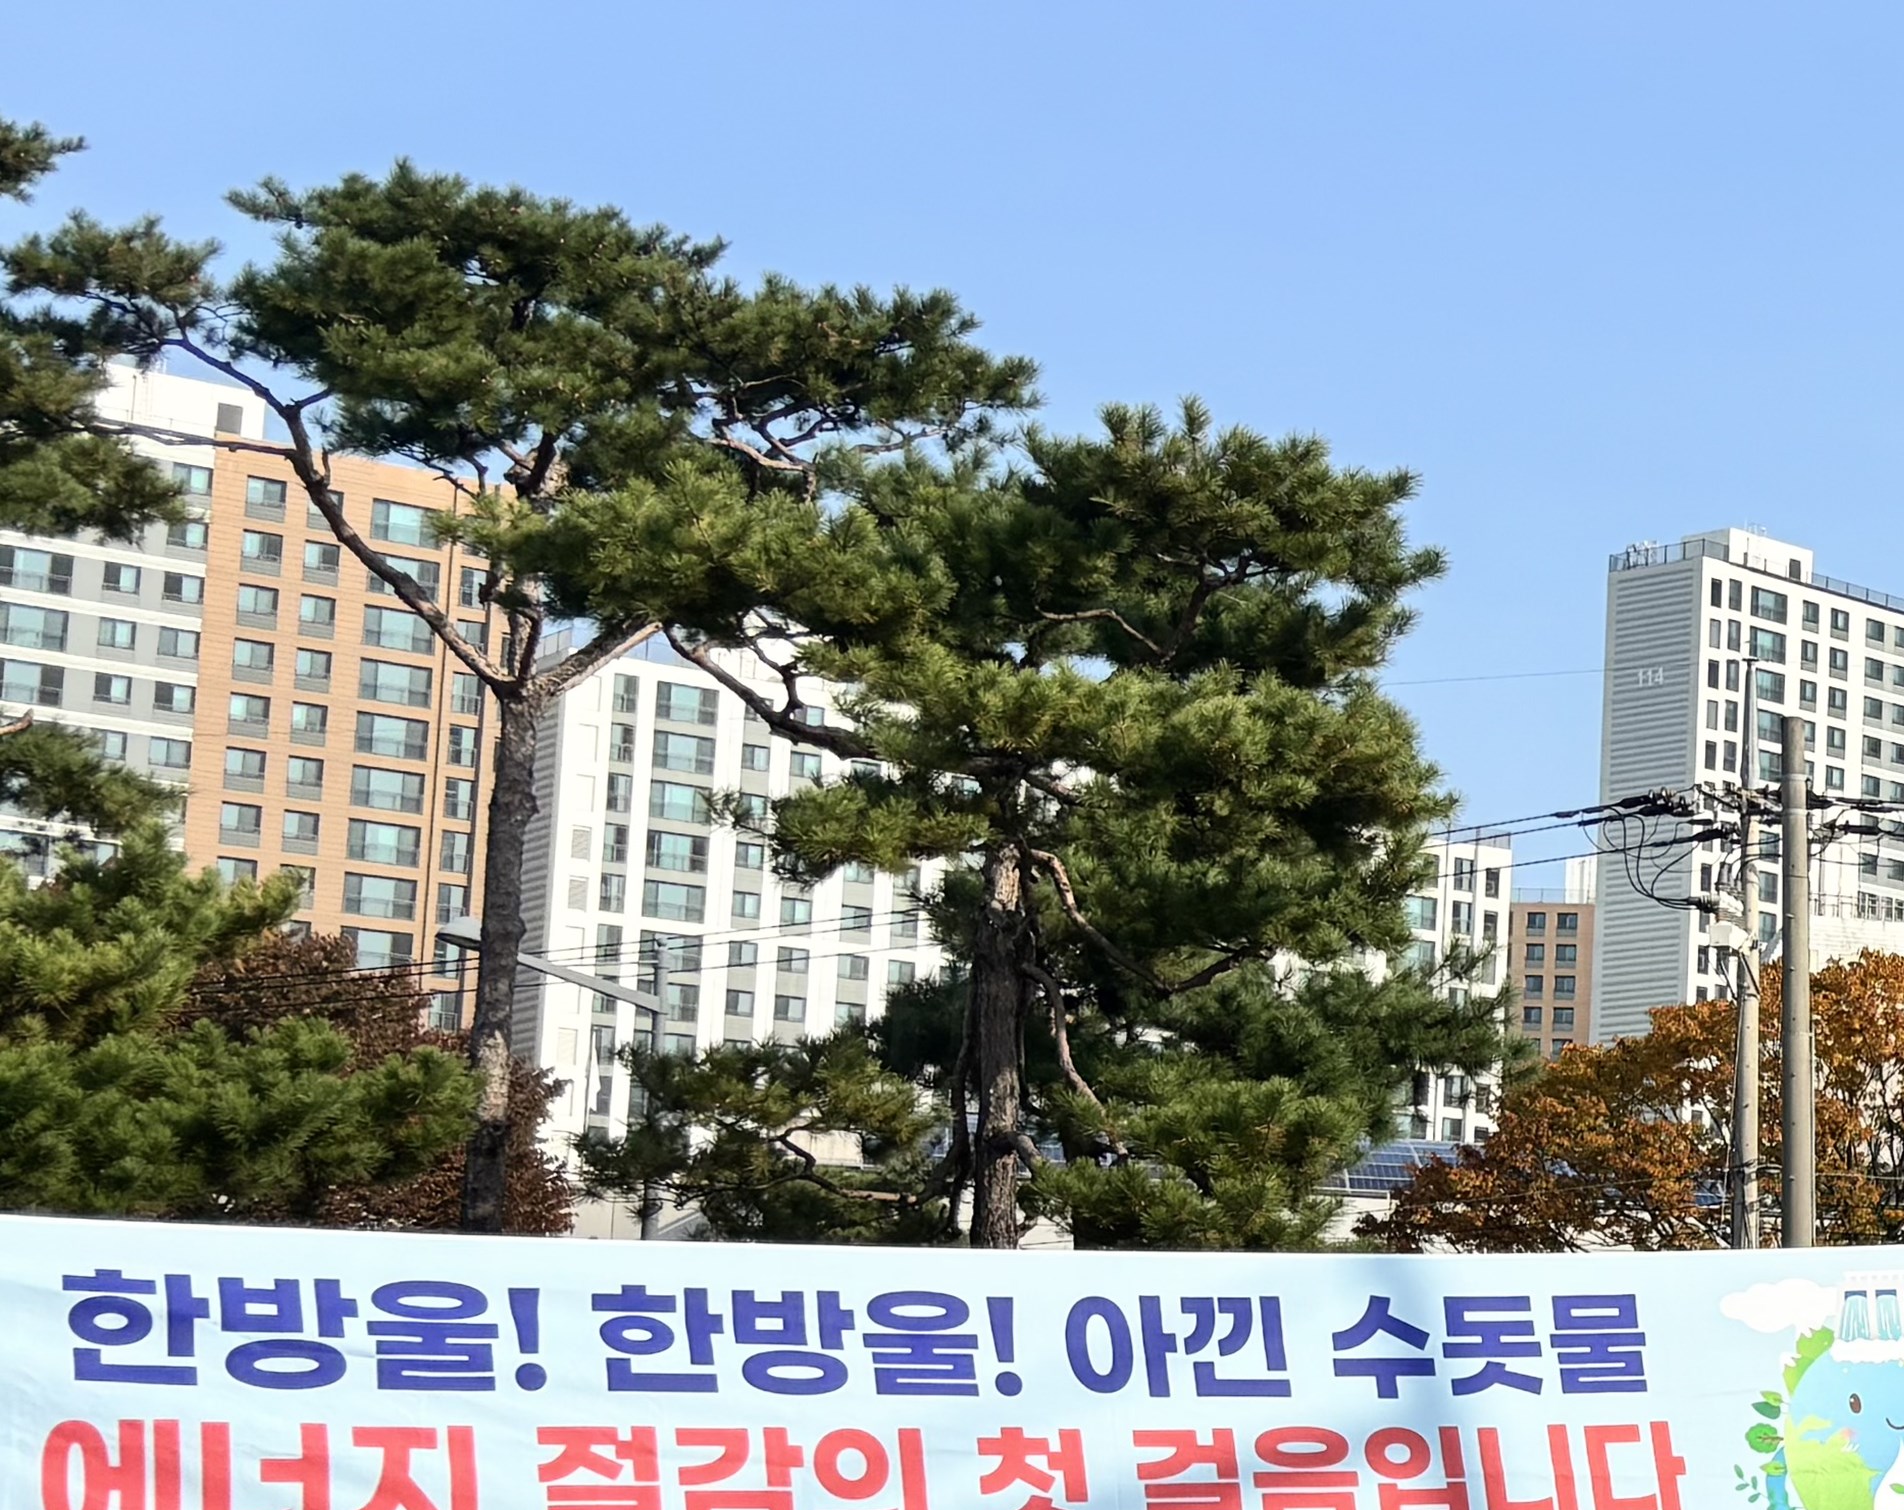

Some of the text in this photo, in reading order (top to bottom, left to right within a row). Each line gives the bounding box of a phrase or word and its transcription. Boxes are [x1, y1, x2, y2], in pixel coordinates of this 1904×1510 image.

[1638, 666, 1663, 687] 114
[56, 1269, 1646, 1399] 한방울! 한방울! 아낀 수돗물
